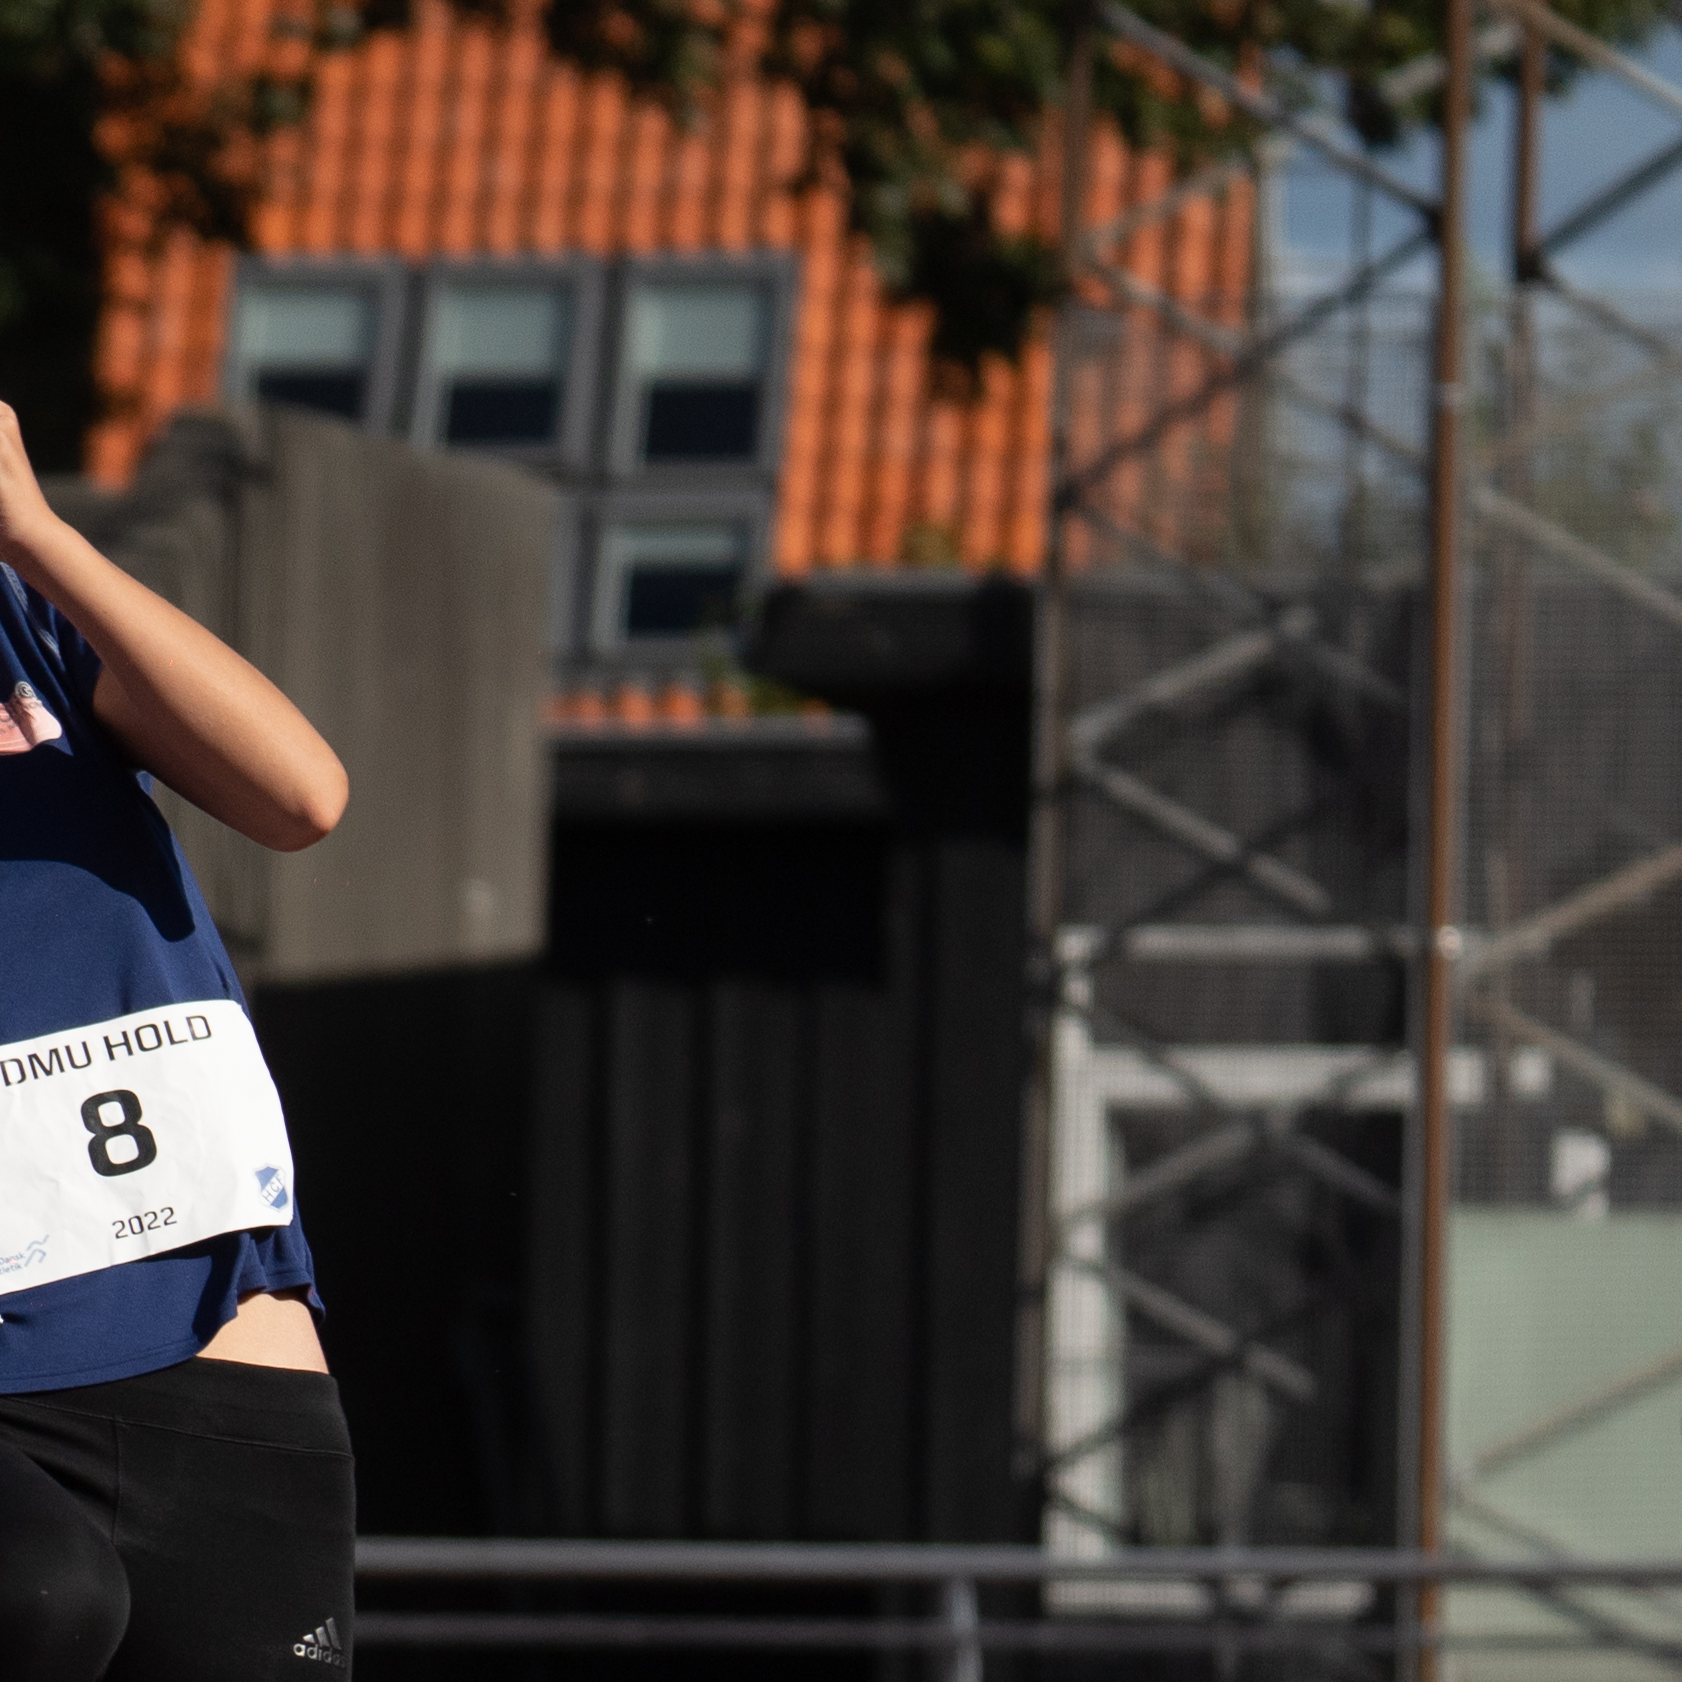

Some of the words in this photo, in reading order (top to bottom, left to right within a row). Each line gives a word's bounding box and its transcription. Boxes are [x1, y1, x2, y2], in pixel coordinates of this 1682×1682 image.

[103, 1014, 213, 1062] HOLD
[80, 1088, 158, 1178] 8
[112, 1206, 178, 1240] 2022
[293, 1643, 346, 1669] adidas
